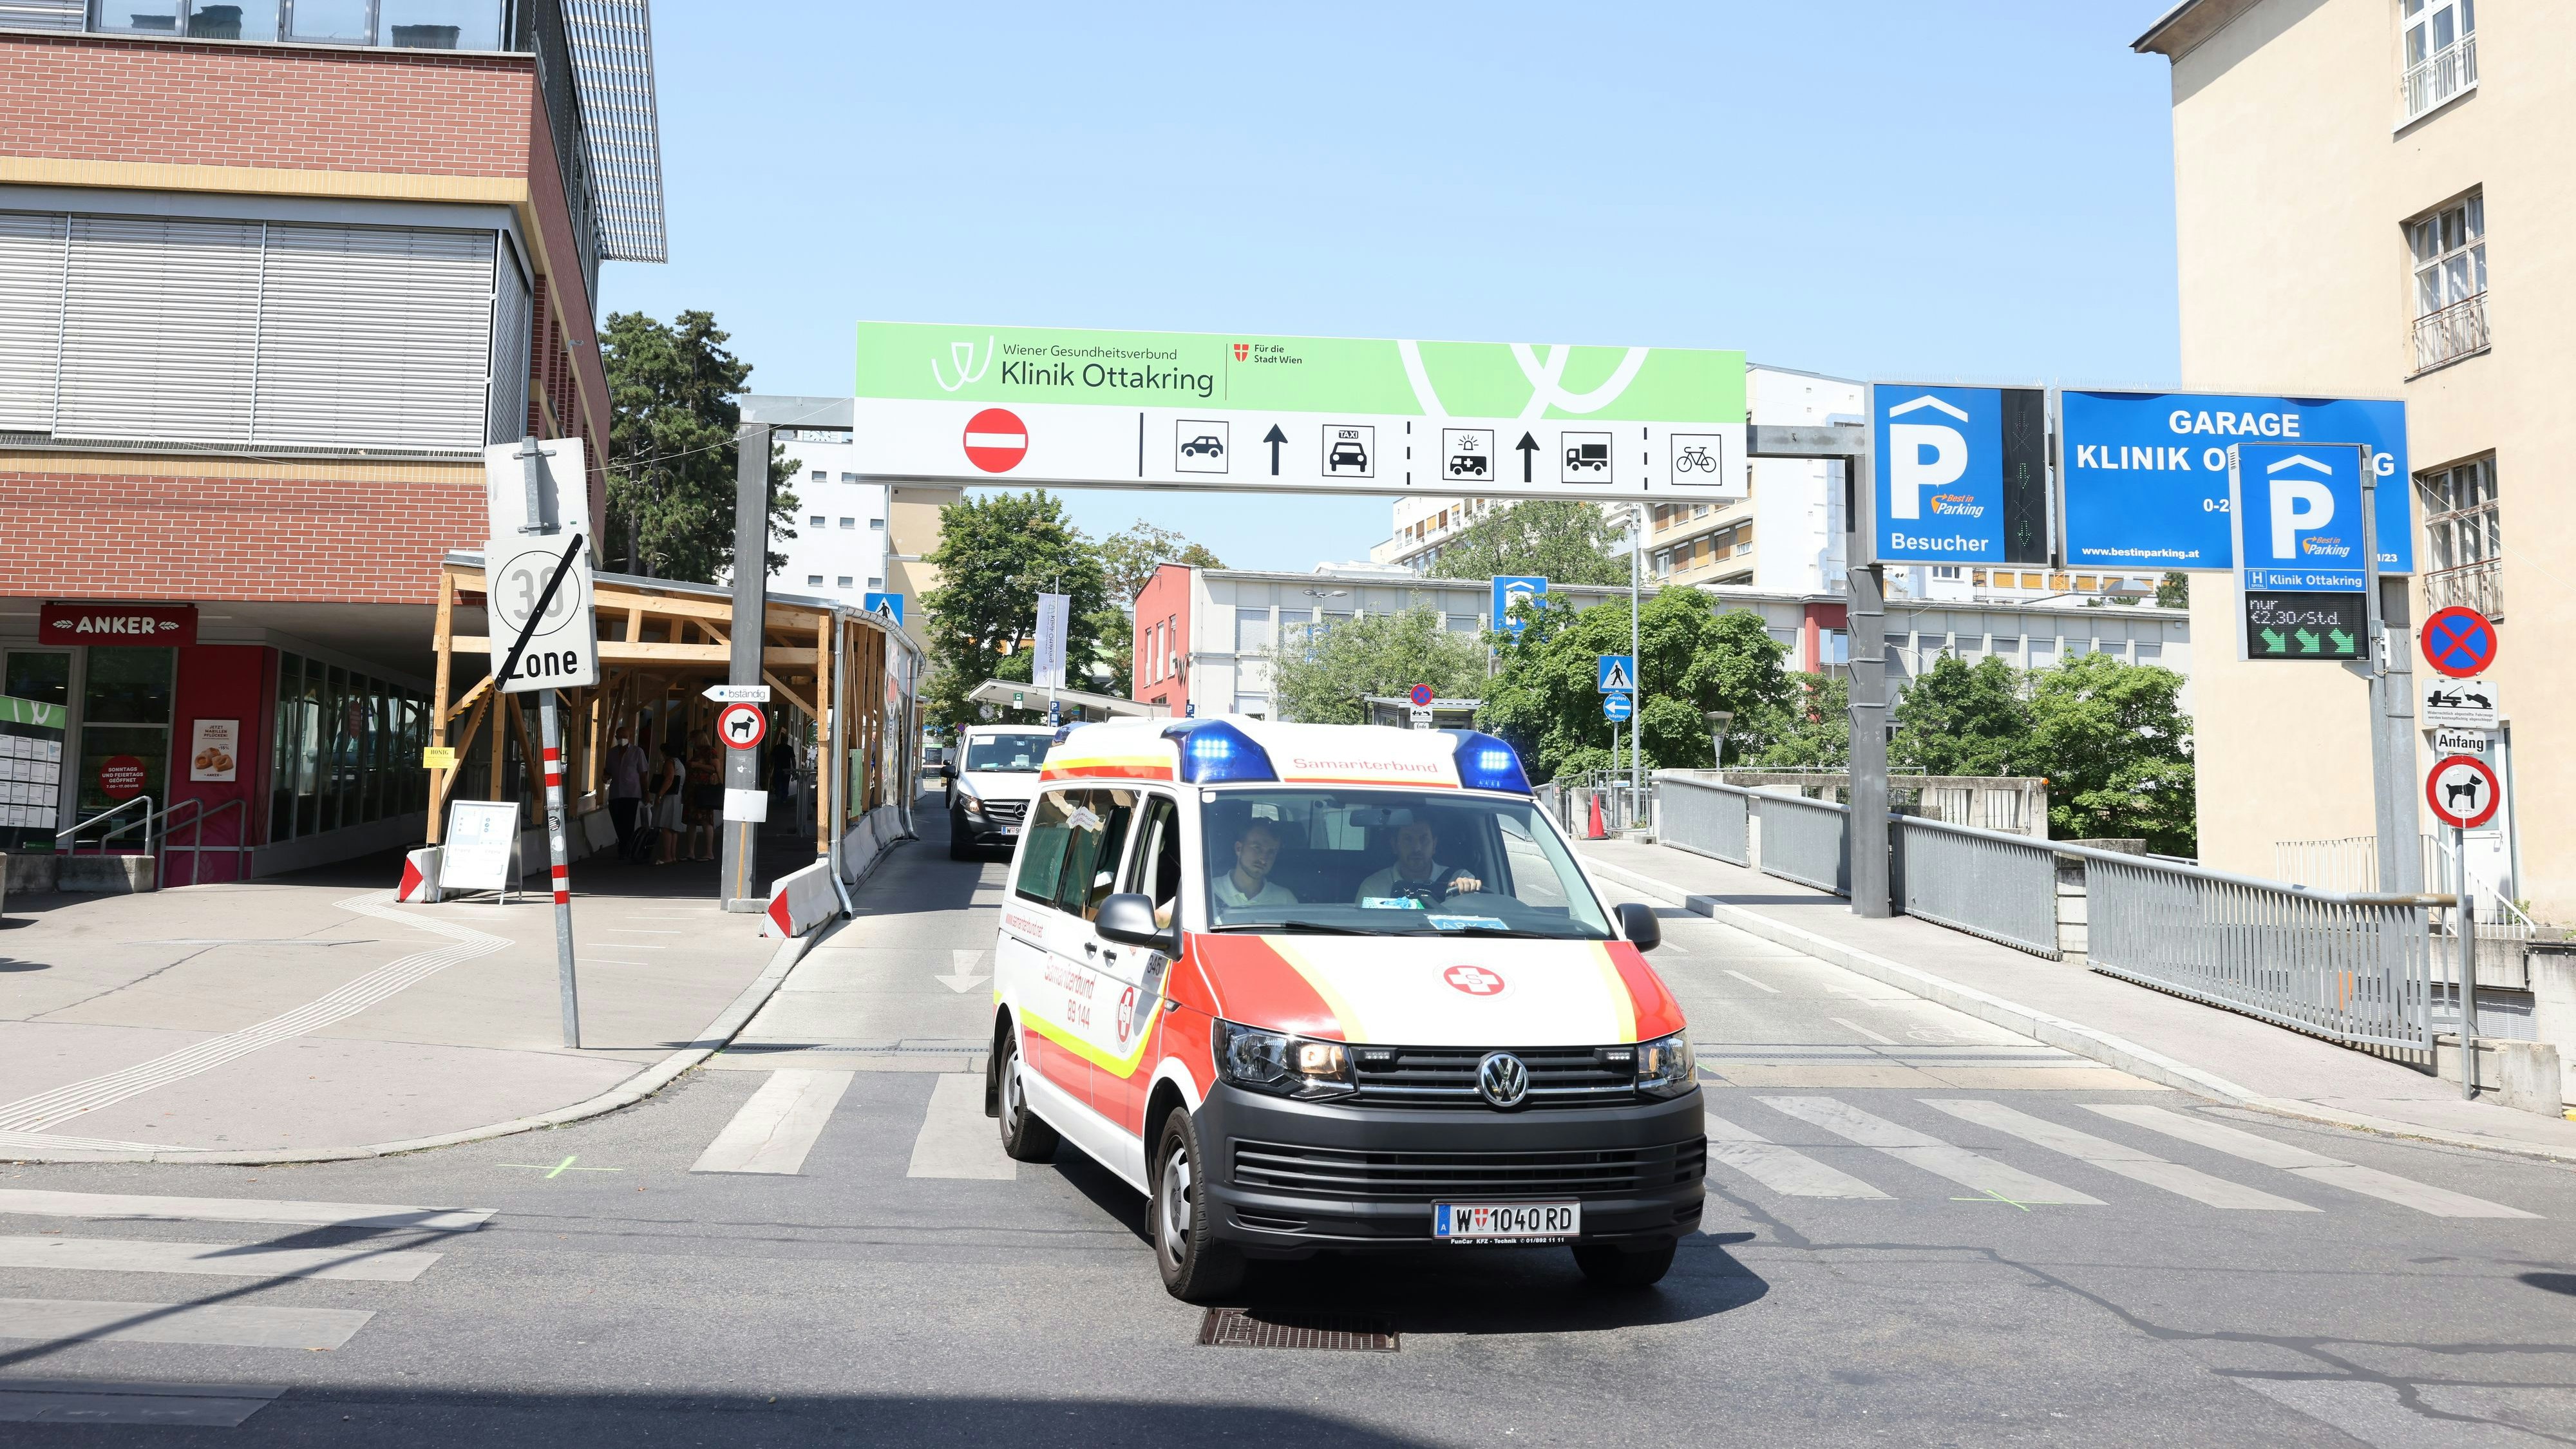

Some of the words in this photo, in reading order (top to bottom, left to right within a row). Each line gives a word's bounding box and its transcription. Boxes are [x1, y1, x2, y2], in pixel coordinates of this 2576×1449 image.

[1003, 343, 1047, 355] Wiener
[1050, 345, 1177, 360] Gesundheitsverbund
[1255, 344, 1269, 352] Für
[1255, 355, 1277, 363] Stadt
[1279, 355, 1302, 364] Wien
[1002, 361, 1075, 386] Klinik
[1083, 363, 1213, 398] Ottakring
[2169, 410, 2300, 437] GARAGE
[2077, 444, 2192, 471] KLINIK
[1889, 423, 1968, 520] P
[1947, 494, 1965, 502] Best
[2203, 498, 2231, 513] 0-2
[1937, 502, 1984, 518] Parking
[2269, 480, 2334, 559] P
[1891, 533, 1989, 551] Besucher
[2082, 547, 2199, 559] www.bestinparking.at
[2307, 544, 2350, 558] Parking
[2253, 572, 2262, 583] H
[2270, 574, 2302, 585] Klinik
[2306, 575, 2362, 587] Ottakring
[511, 566, 564, 620] 30
[2249, 600, 2278, 610] nur
[75, 616, 155, 634] ANKER
[2250, 611, 2341, 625] €2,30/Std.
[728, 689, 765, 700] bständig
[2439, 734, 2484, 752] Anfang
[1293, 758, 1438, 773] Samariterbund
[1045, 956, 1097, 999] Samariterbund
[1067, 999, 1076, 1023] 89
[1077, 1003, 1090, 1030] 144
[1456, 1209, 1472, 1231] W
[1490, 1208, 1540, 1231] 1040
[1546, 1208, 1572, 1231] RD
